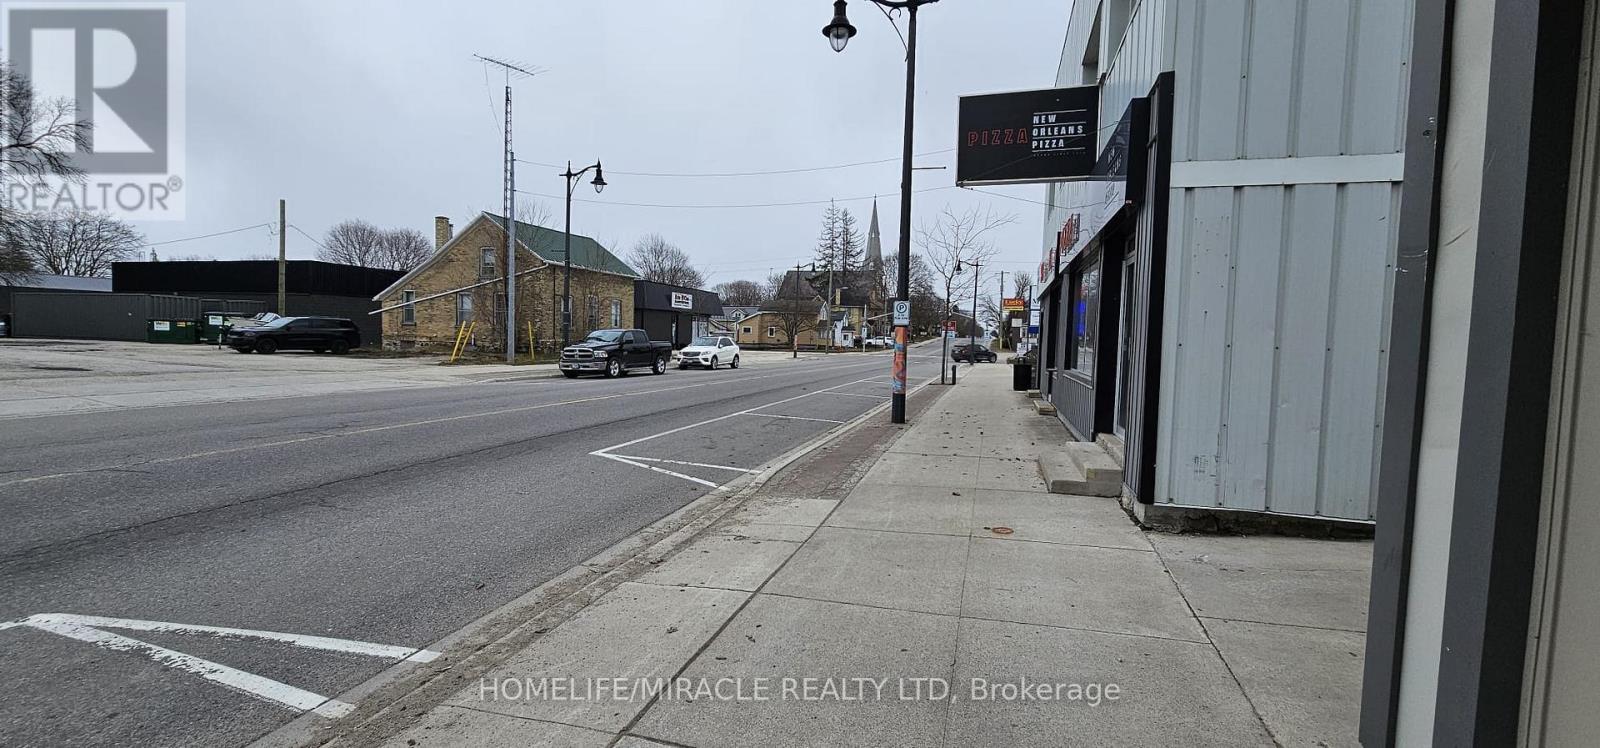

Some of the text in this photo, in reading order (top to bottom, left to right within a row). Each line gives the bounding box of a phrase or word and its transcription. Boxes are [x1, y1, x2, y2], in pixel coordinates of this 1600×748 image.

[1033, 114, 1057, 124] NEW
[1032, 125, 1083, 136] ORLEANS
[967, 128, 1028, 146] PIZZA
[1032, 139, 1064, 149] PIZZA
